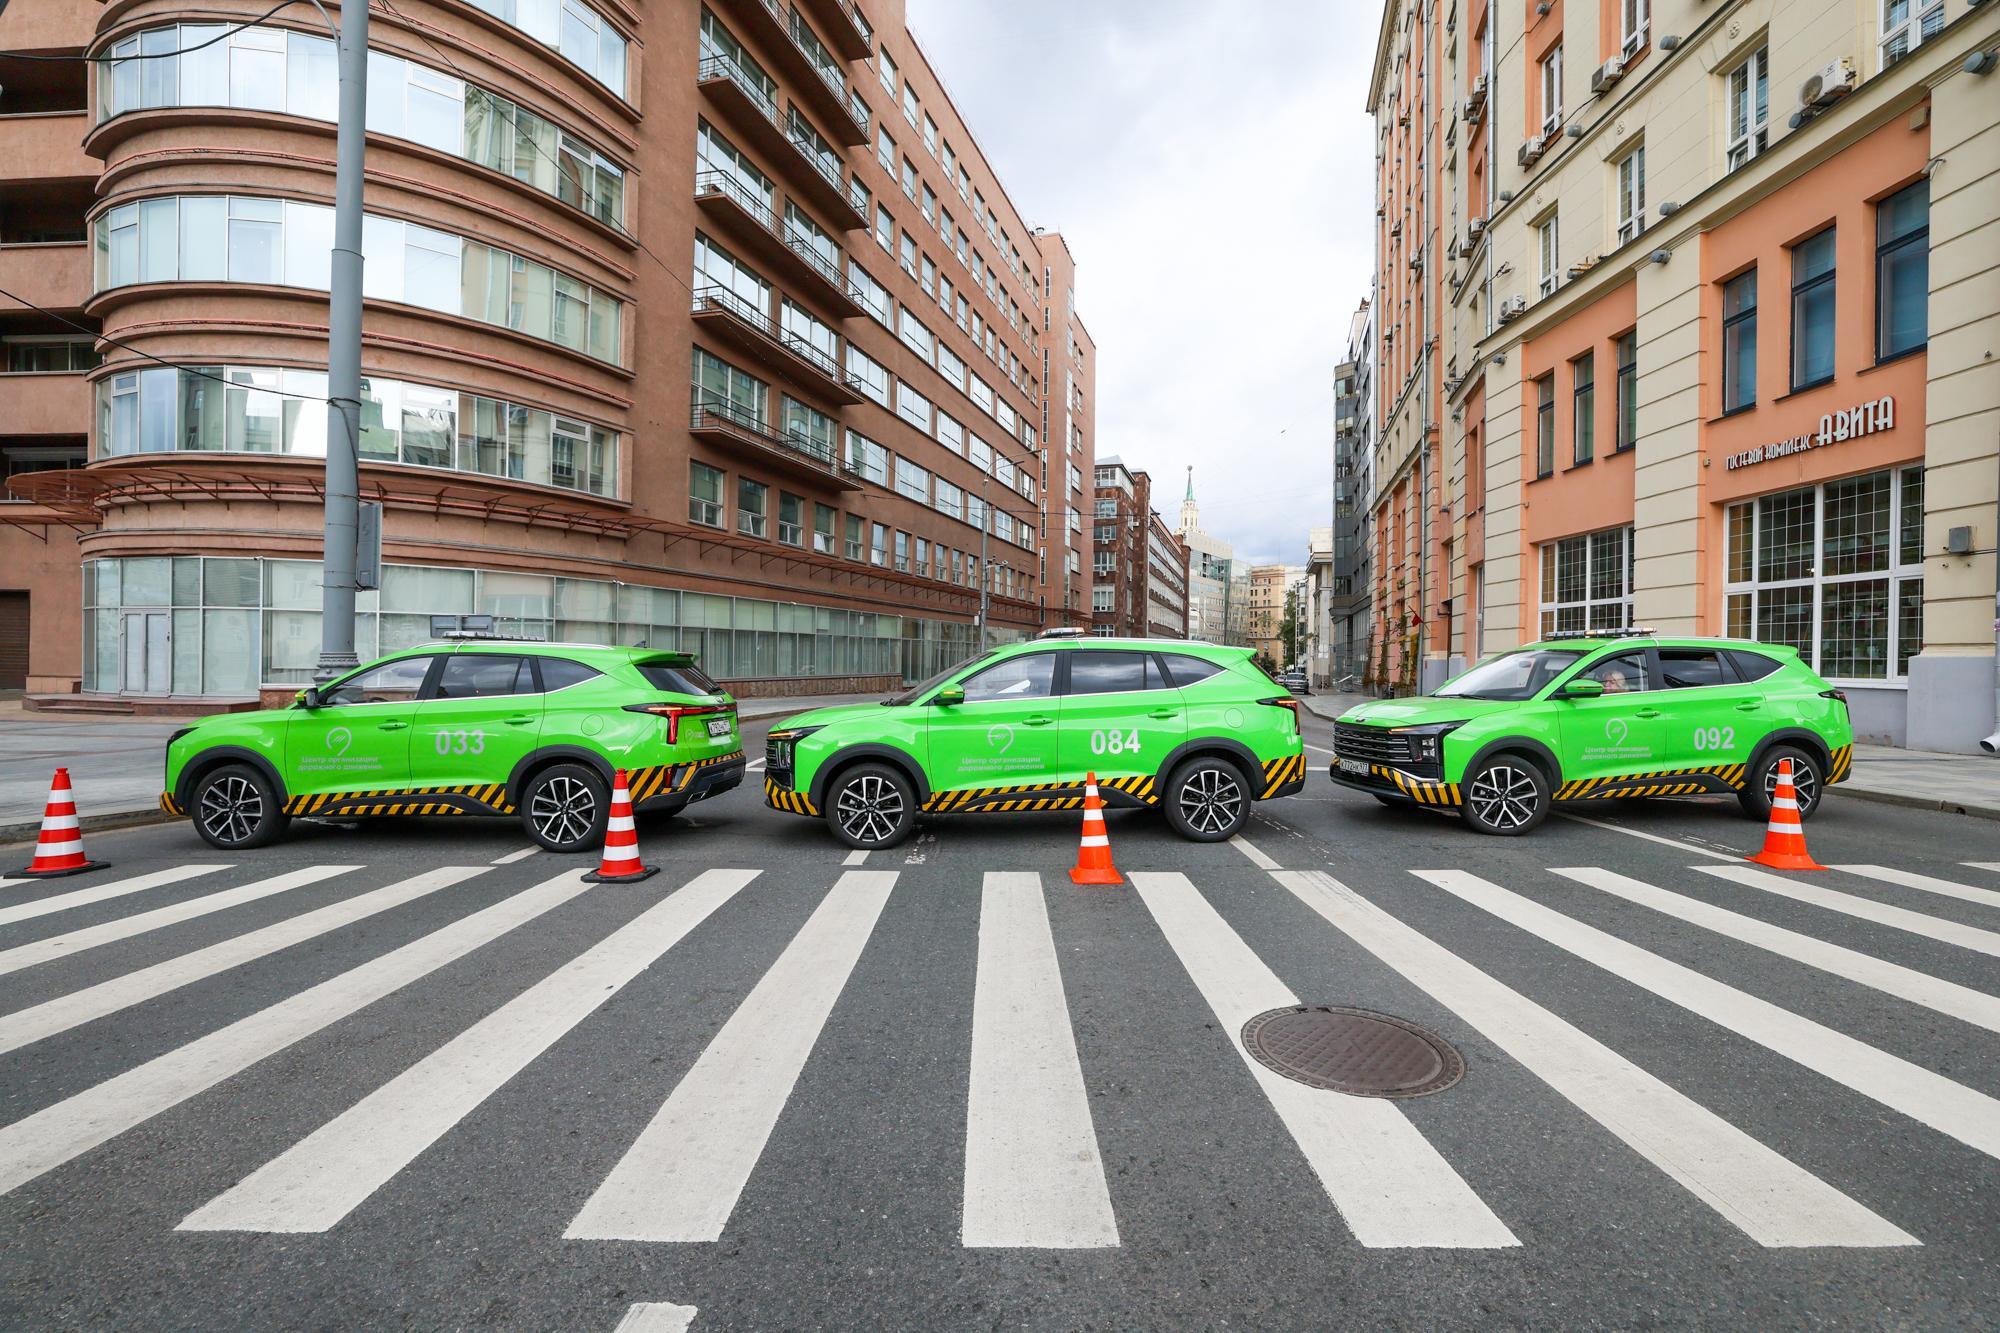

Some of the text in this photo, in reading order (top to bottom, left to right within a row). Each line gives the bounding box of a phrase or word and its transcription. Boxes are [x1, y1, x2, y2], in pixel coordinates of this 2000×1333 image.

[1726, 395, 1894, 471] ГОСТЕВОЙ КОМПЛЕКС АВИТА
[435, 730, 485, 755] 033
[1091, 728, 1141, 755] 084
[1694, 727, 1735, 750] 092
